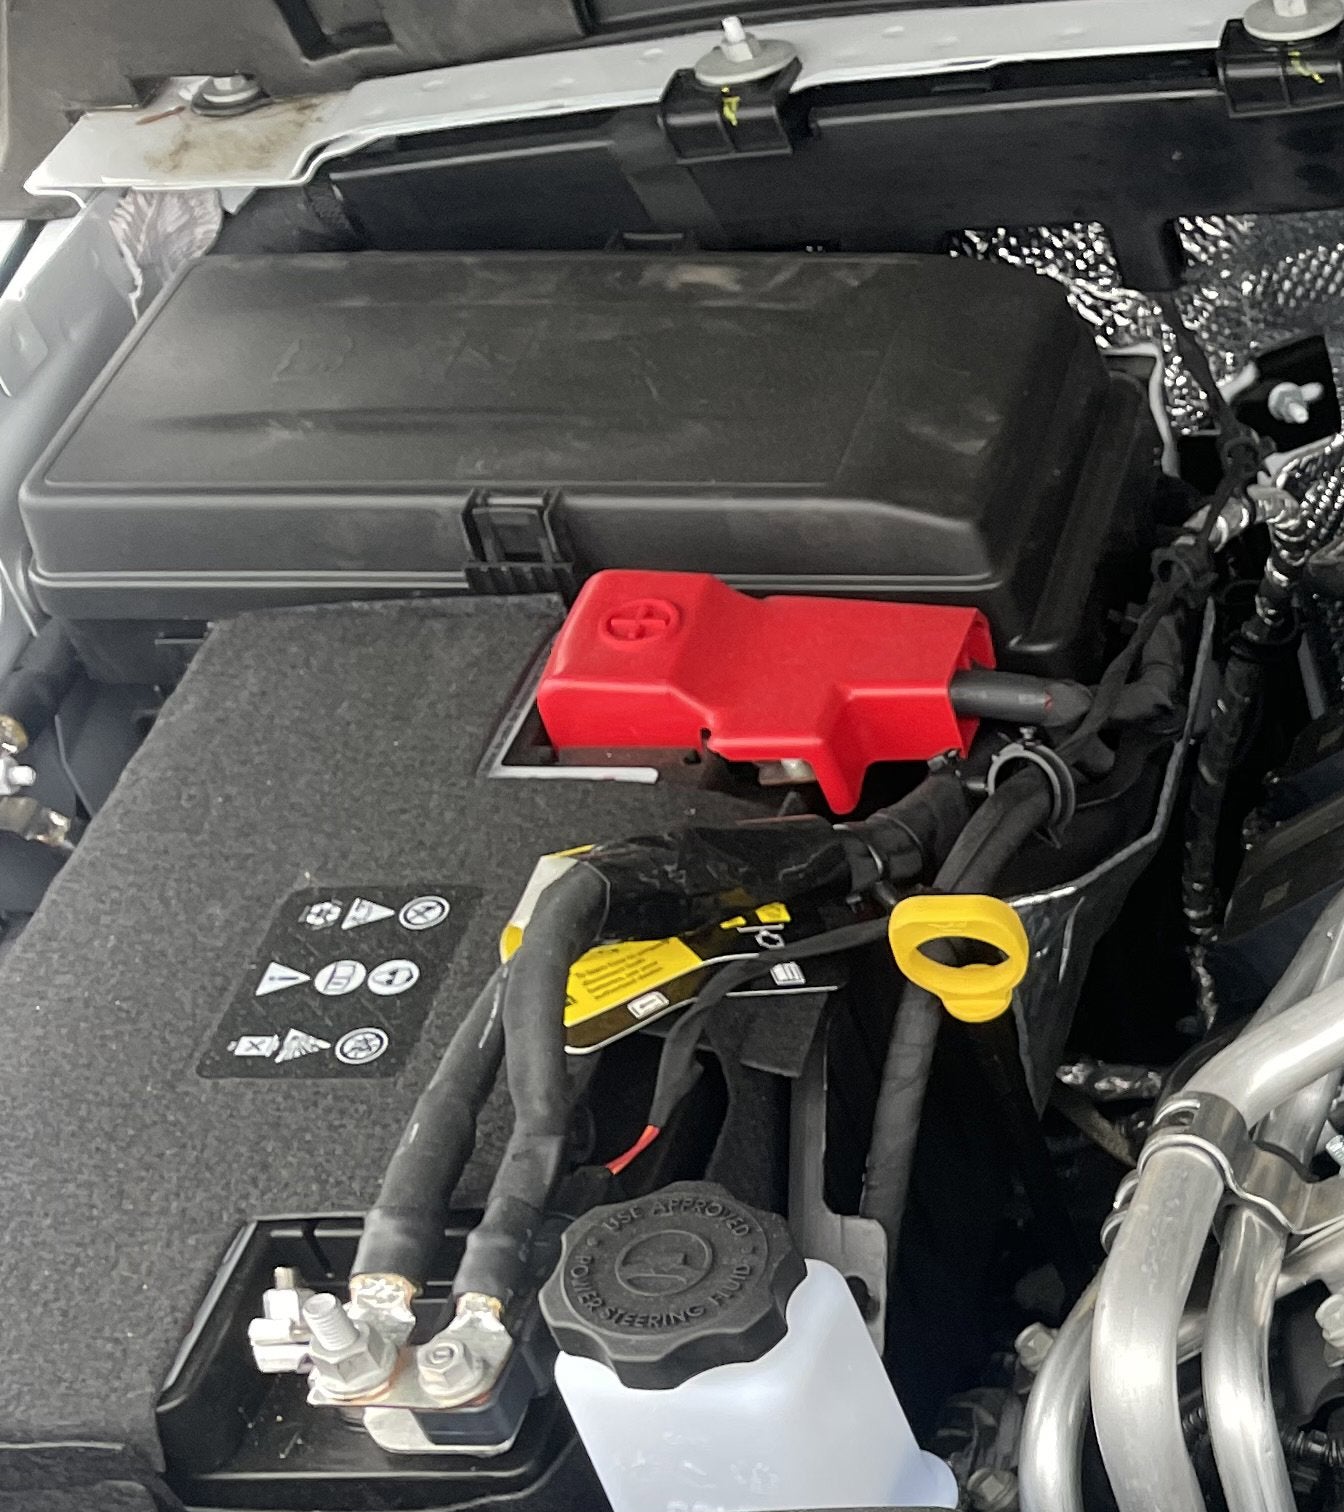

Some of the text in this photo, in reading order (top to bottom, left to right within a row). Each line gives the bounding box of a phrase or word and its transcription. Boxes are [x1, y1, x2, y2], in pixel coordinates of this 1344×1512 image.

[601, 1198, 751, 1238] USE APPROVED
[570, 1254, 752, 1328] POWER STEERING FLUID
